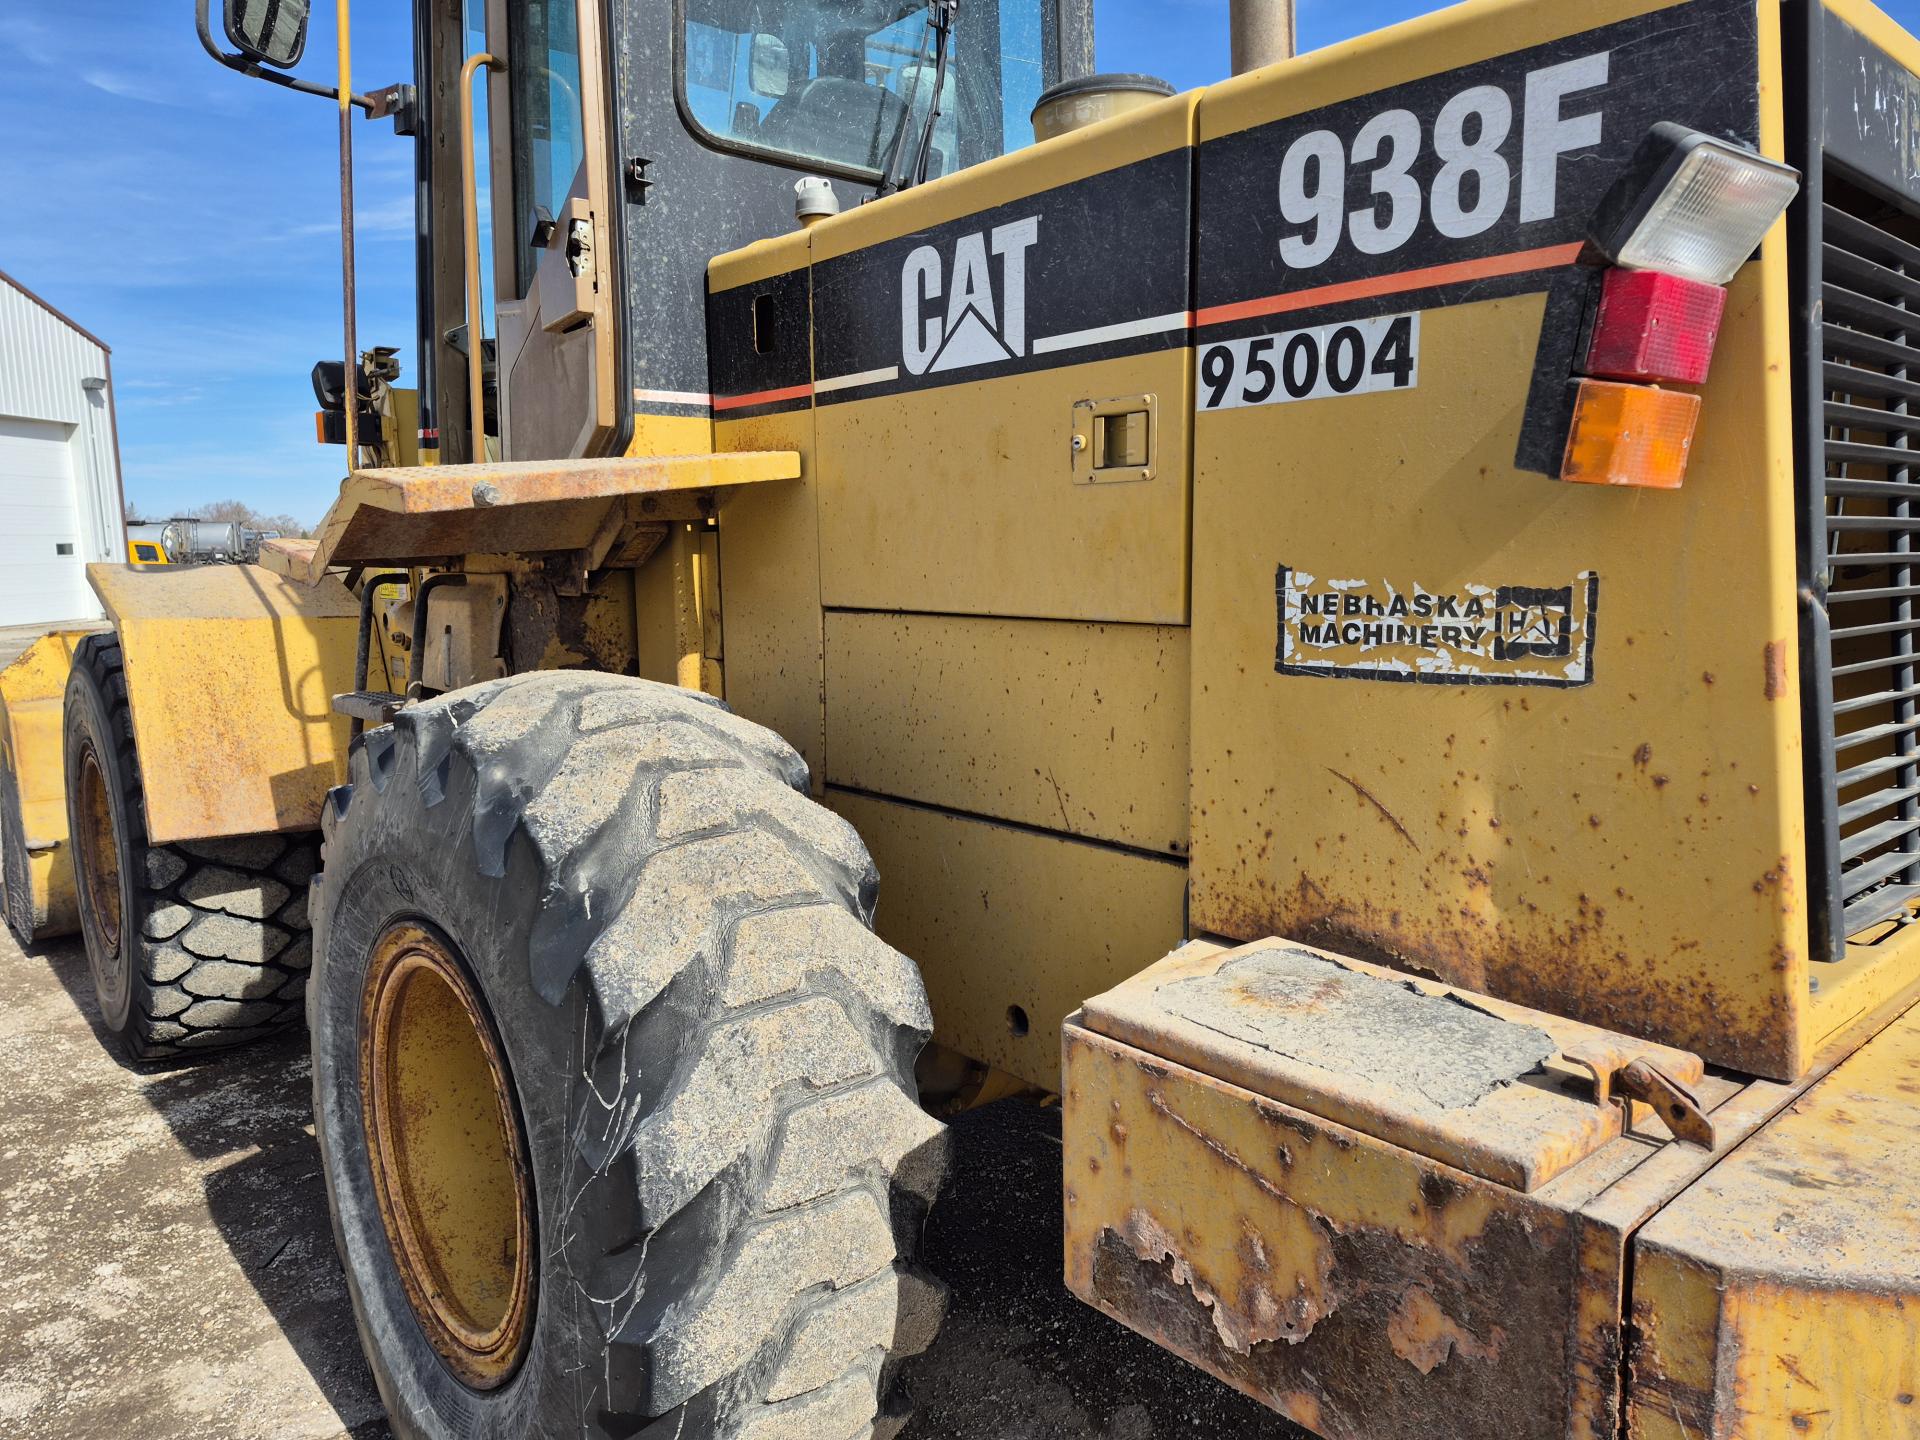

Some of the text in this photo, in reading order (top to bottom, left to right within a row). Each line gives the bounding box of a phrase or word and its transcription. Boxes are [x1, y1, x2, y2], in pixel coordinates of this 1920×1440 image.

[1278, 51, 1610, 269] 938F
[901, 215, 1038, 376] CAT
[1201, 316, 1414, 408] 95004
[1300, 593, 1486, 619] NEBRASKA
[1300, 622, 1487, 650] MACHINERY
